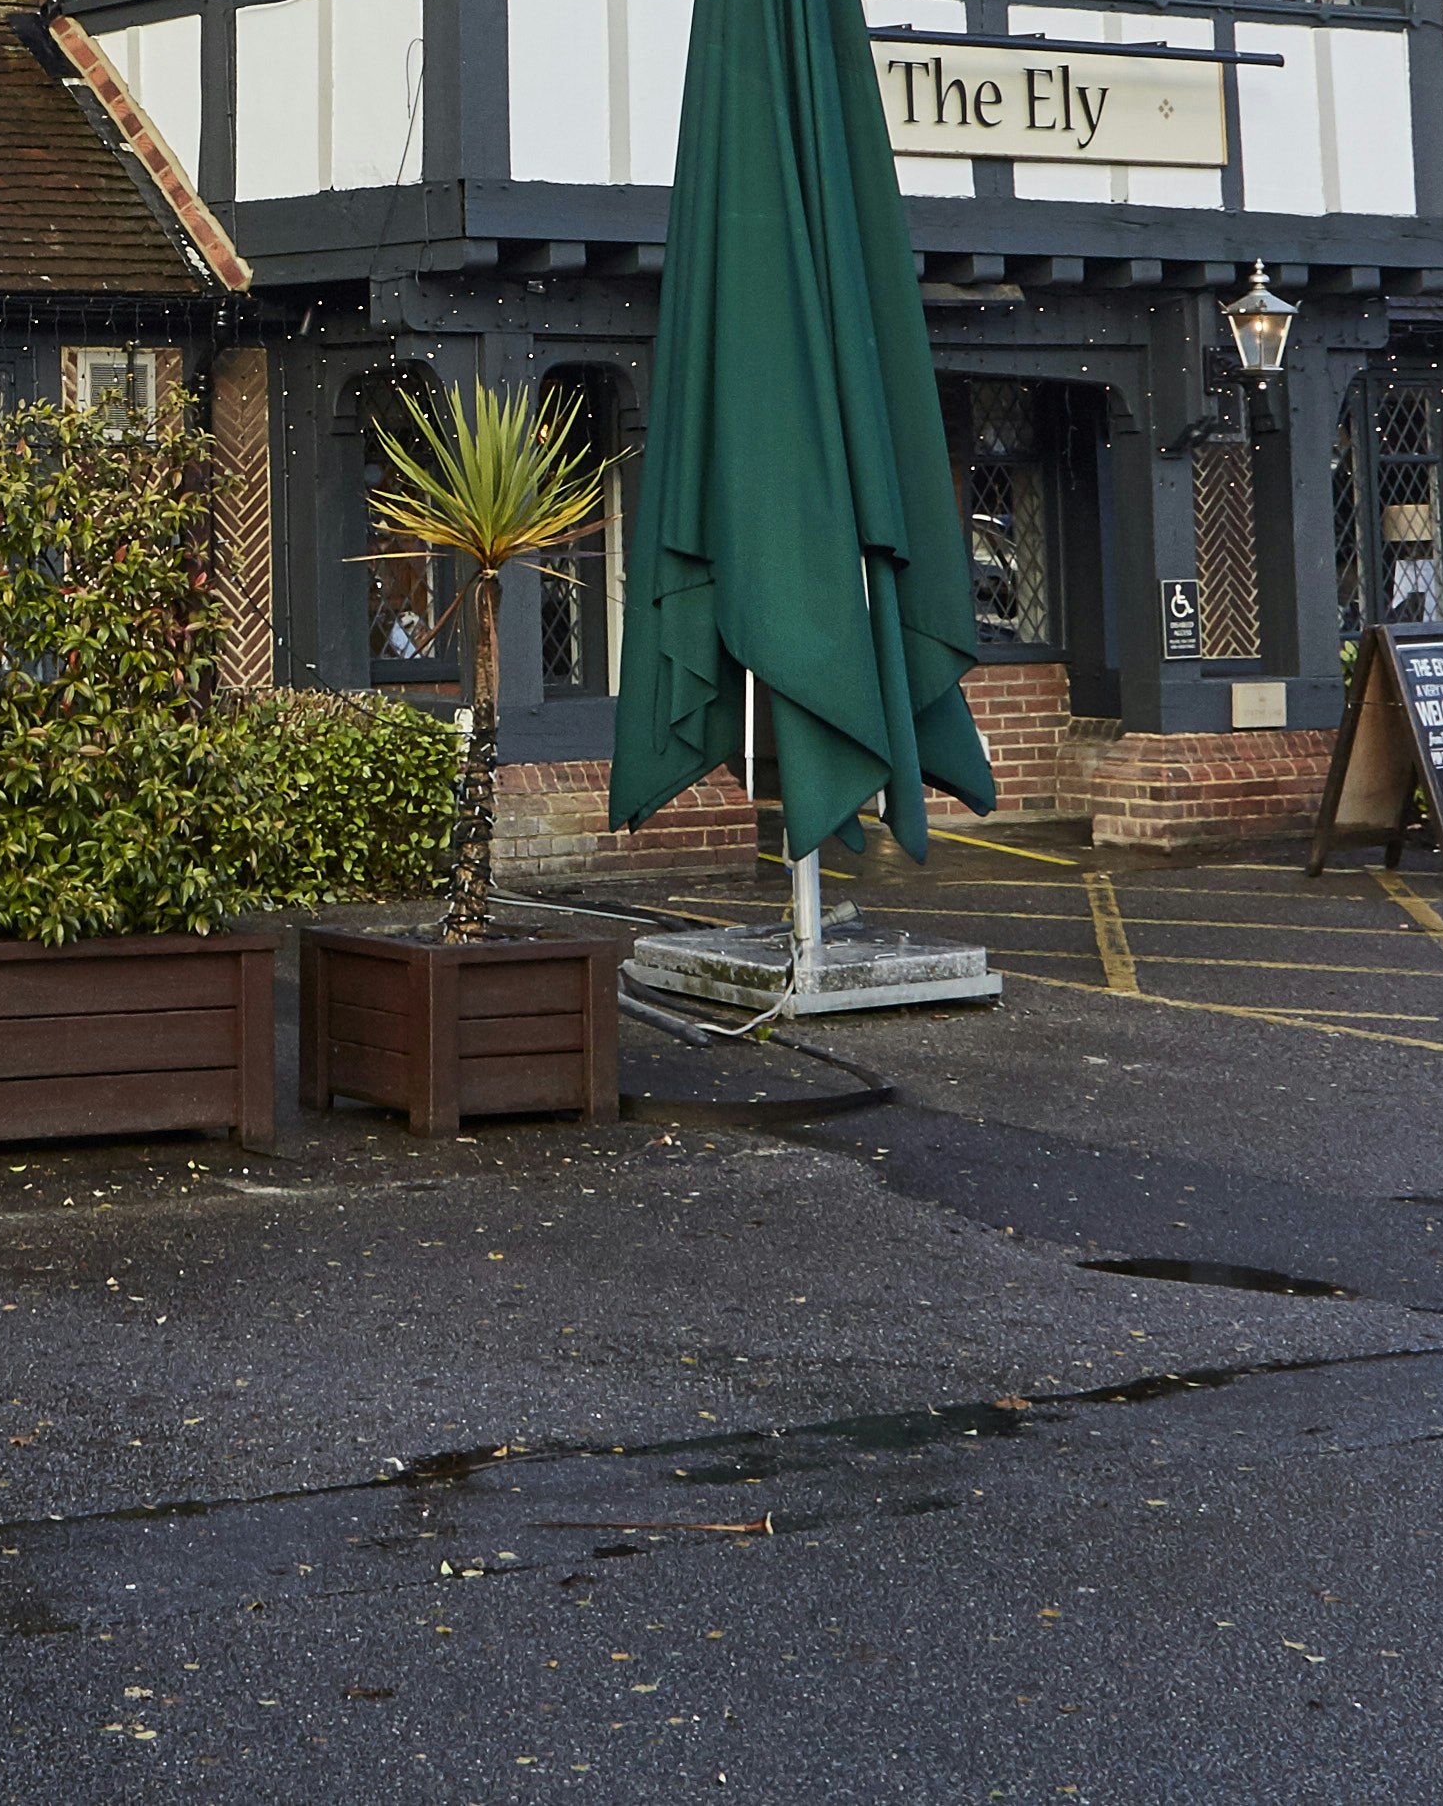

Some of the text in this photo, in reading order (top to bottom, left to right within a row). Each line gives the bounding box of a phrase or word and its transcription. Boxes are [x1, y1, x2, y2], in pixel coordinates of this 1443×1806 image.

[887, 57, 1110, 149] The Ely
[1410, 657, 1433, 678] THE
